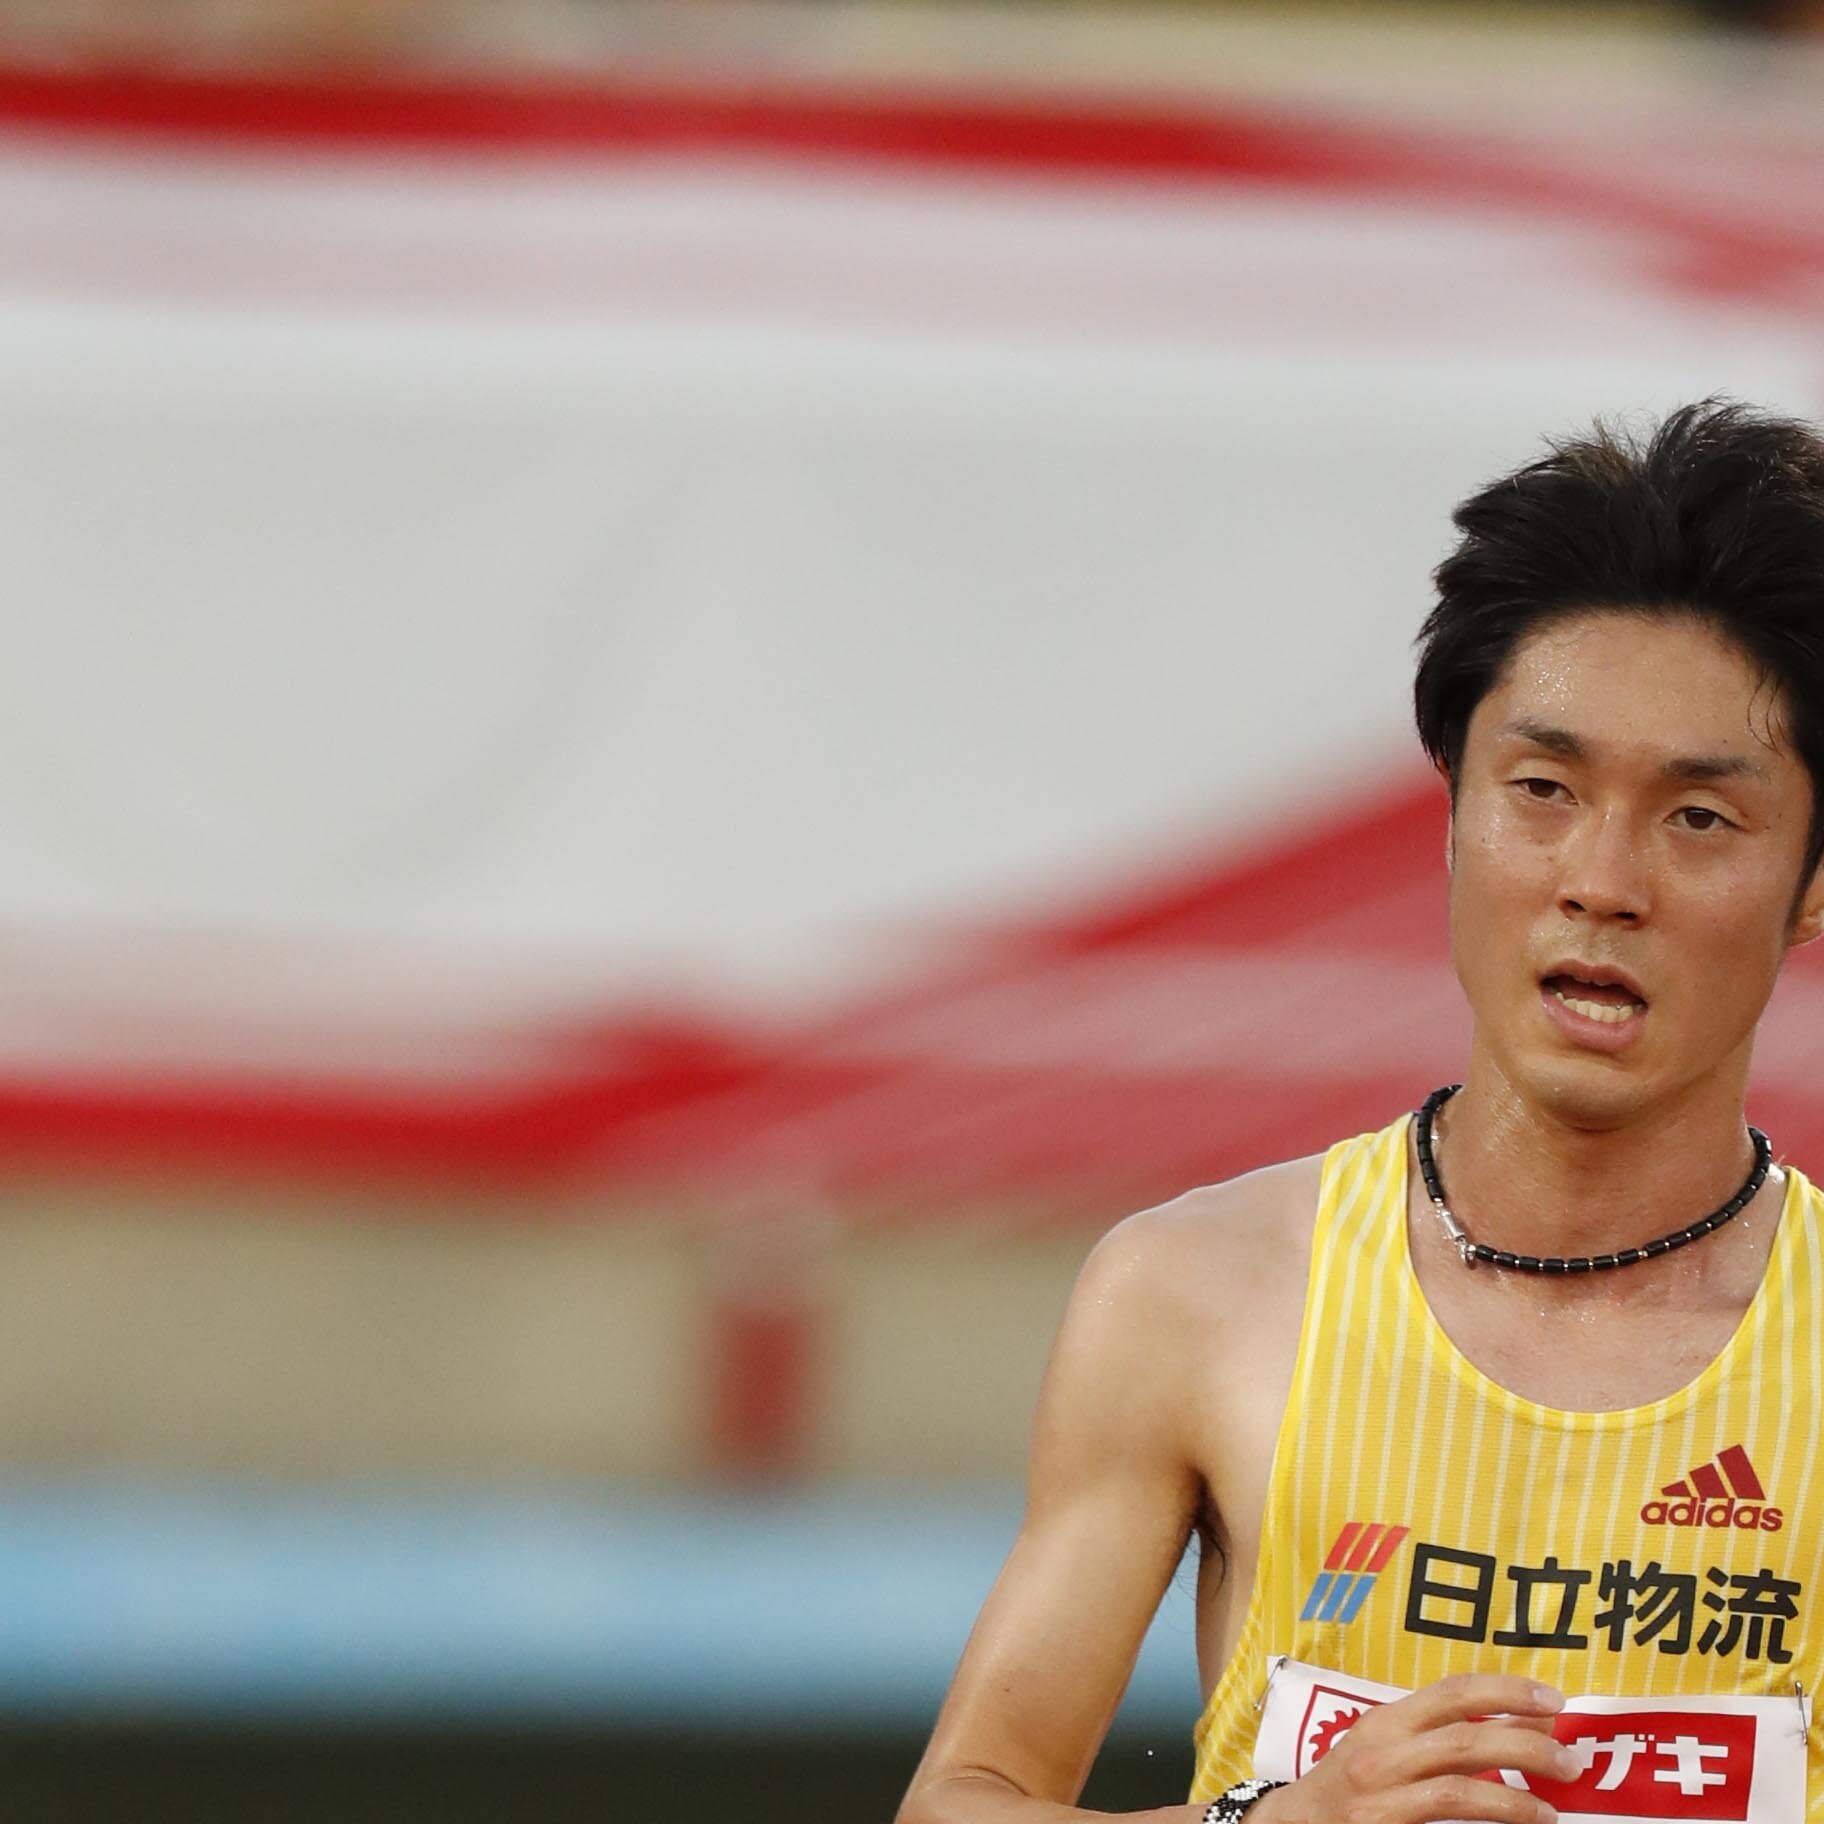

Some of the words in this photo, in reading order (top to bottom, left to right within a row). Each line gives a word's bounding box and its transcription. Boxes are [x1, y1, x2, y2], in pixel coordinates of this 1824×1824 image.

[1640, 1496, 1783, 1532] adidas
[1404, 1542, 1801, 1664] 日立物流
